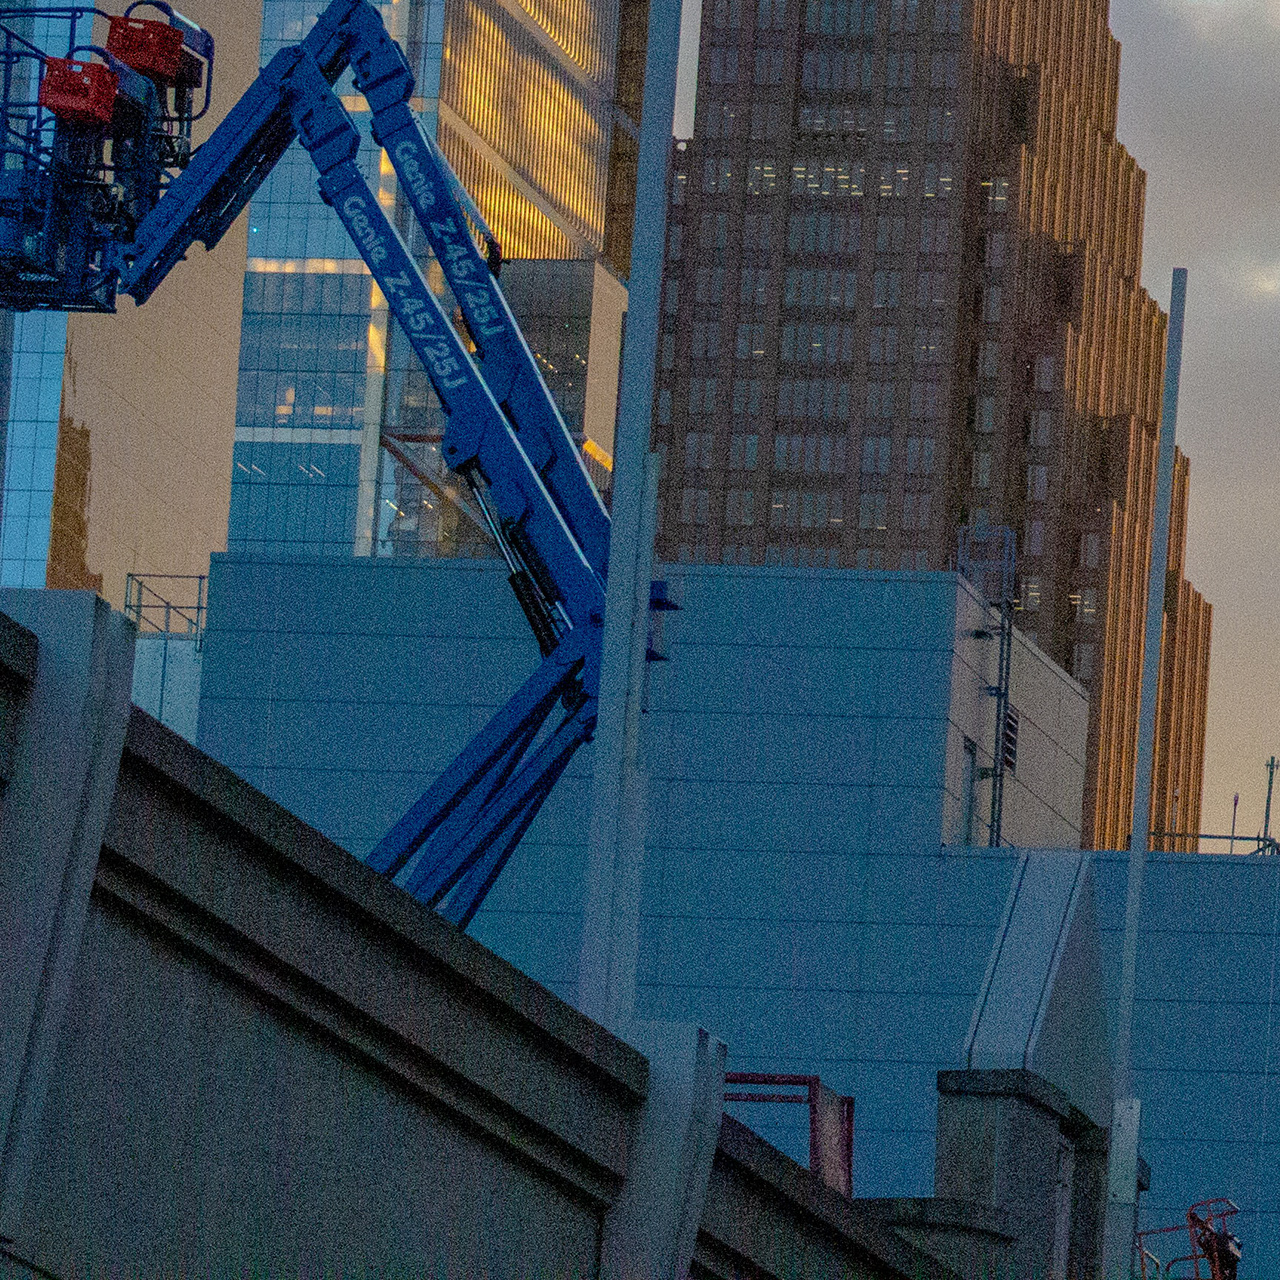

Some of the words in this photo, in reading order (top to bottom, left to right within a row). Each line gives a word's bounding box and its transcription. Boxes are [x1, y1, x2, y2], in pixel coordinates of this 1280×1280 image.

[343, 196, 388, 269] Genie
[383, 270, 469, 391] Z-45/25J
[395, 140, 437, 211] Genie
[430, 217, 506, 337] Z-45/25J
